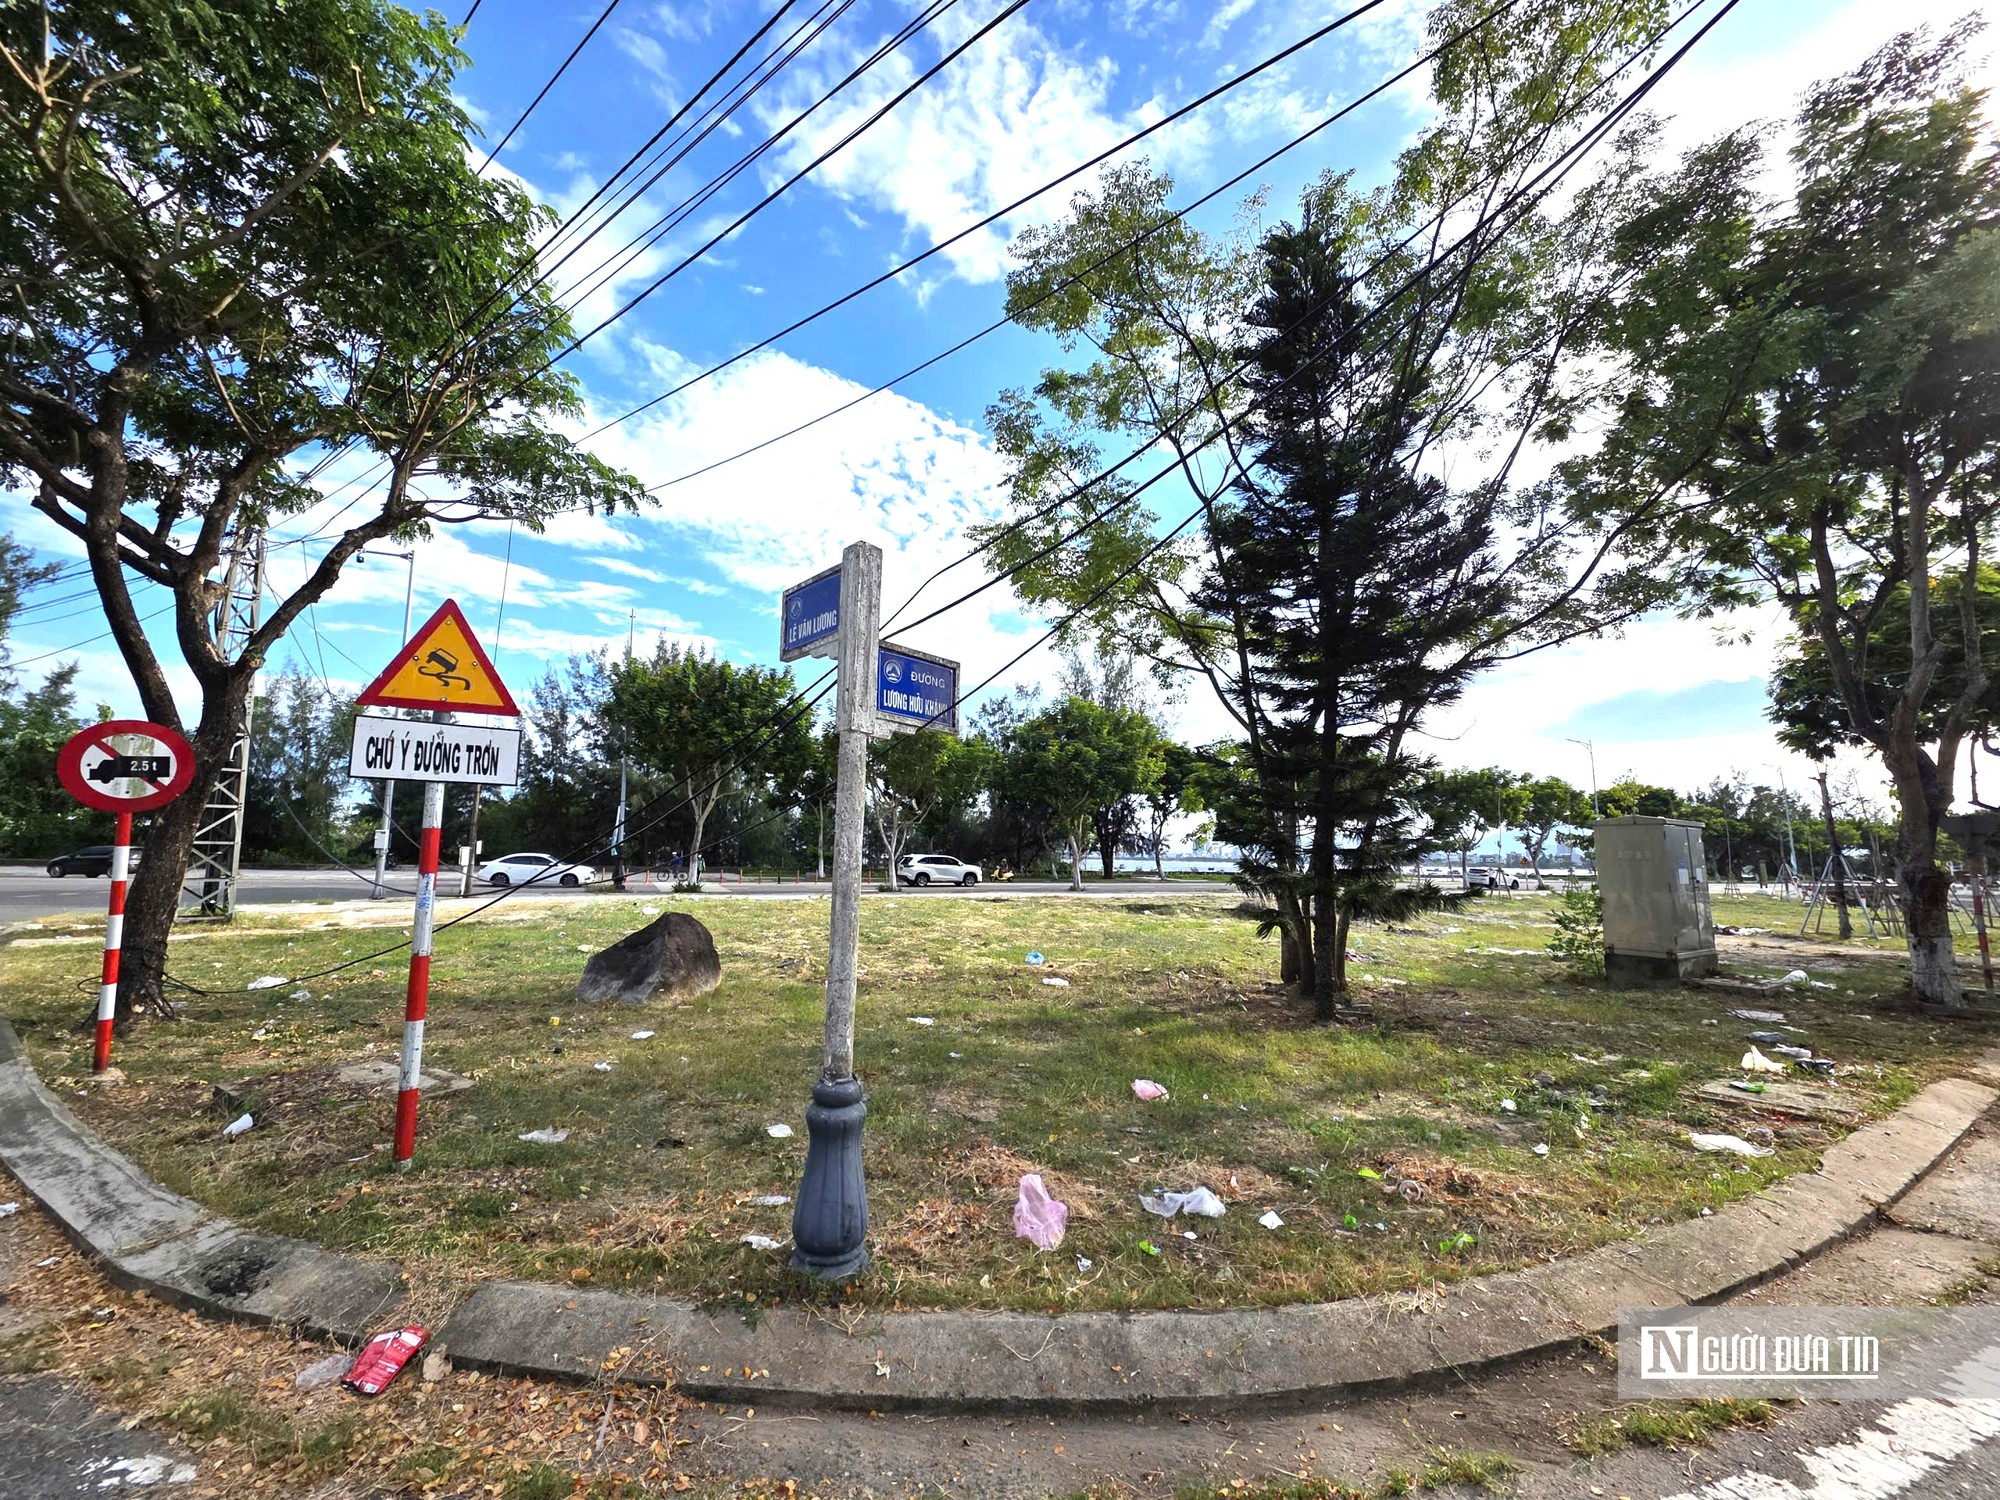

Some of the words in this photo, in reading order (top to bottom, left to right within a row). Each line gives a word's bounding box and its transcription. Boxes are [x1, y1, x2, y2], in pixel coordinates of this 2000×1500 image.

[789, 623, 797, 643] LÊ
[798, 619, 812, 640] VĂN
[813, 609, 837, 634] LƯƠNG
[910, 671, 945, 688] ĐƯỜNG
[883, 689, 907, 711] LƯƠNG
[909, 692, 923, 714] HỮU
[366, 730, 395, 770] CHÚ
[400, 731, 410, 771] Ý
[414, 730, 461, 774] ĐƯỜNG
[130, 760, 149, 772] 2.5
[152, 761, 158, 771] t
